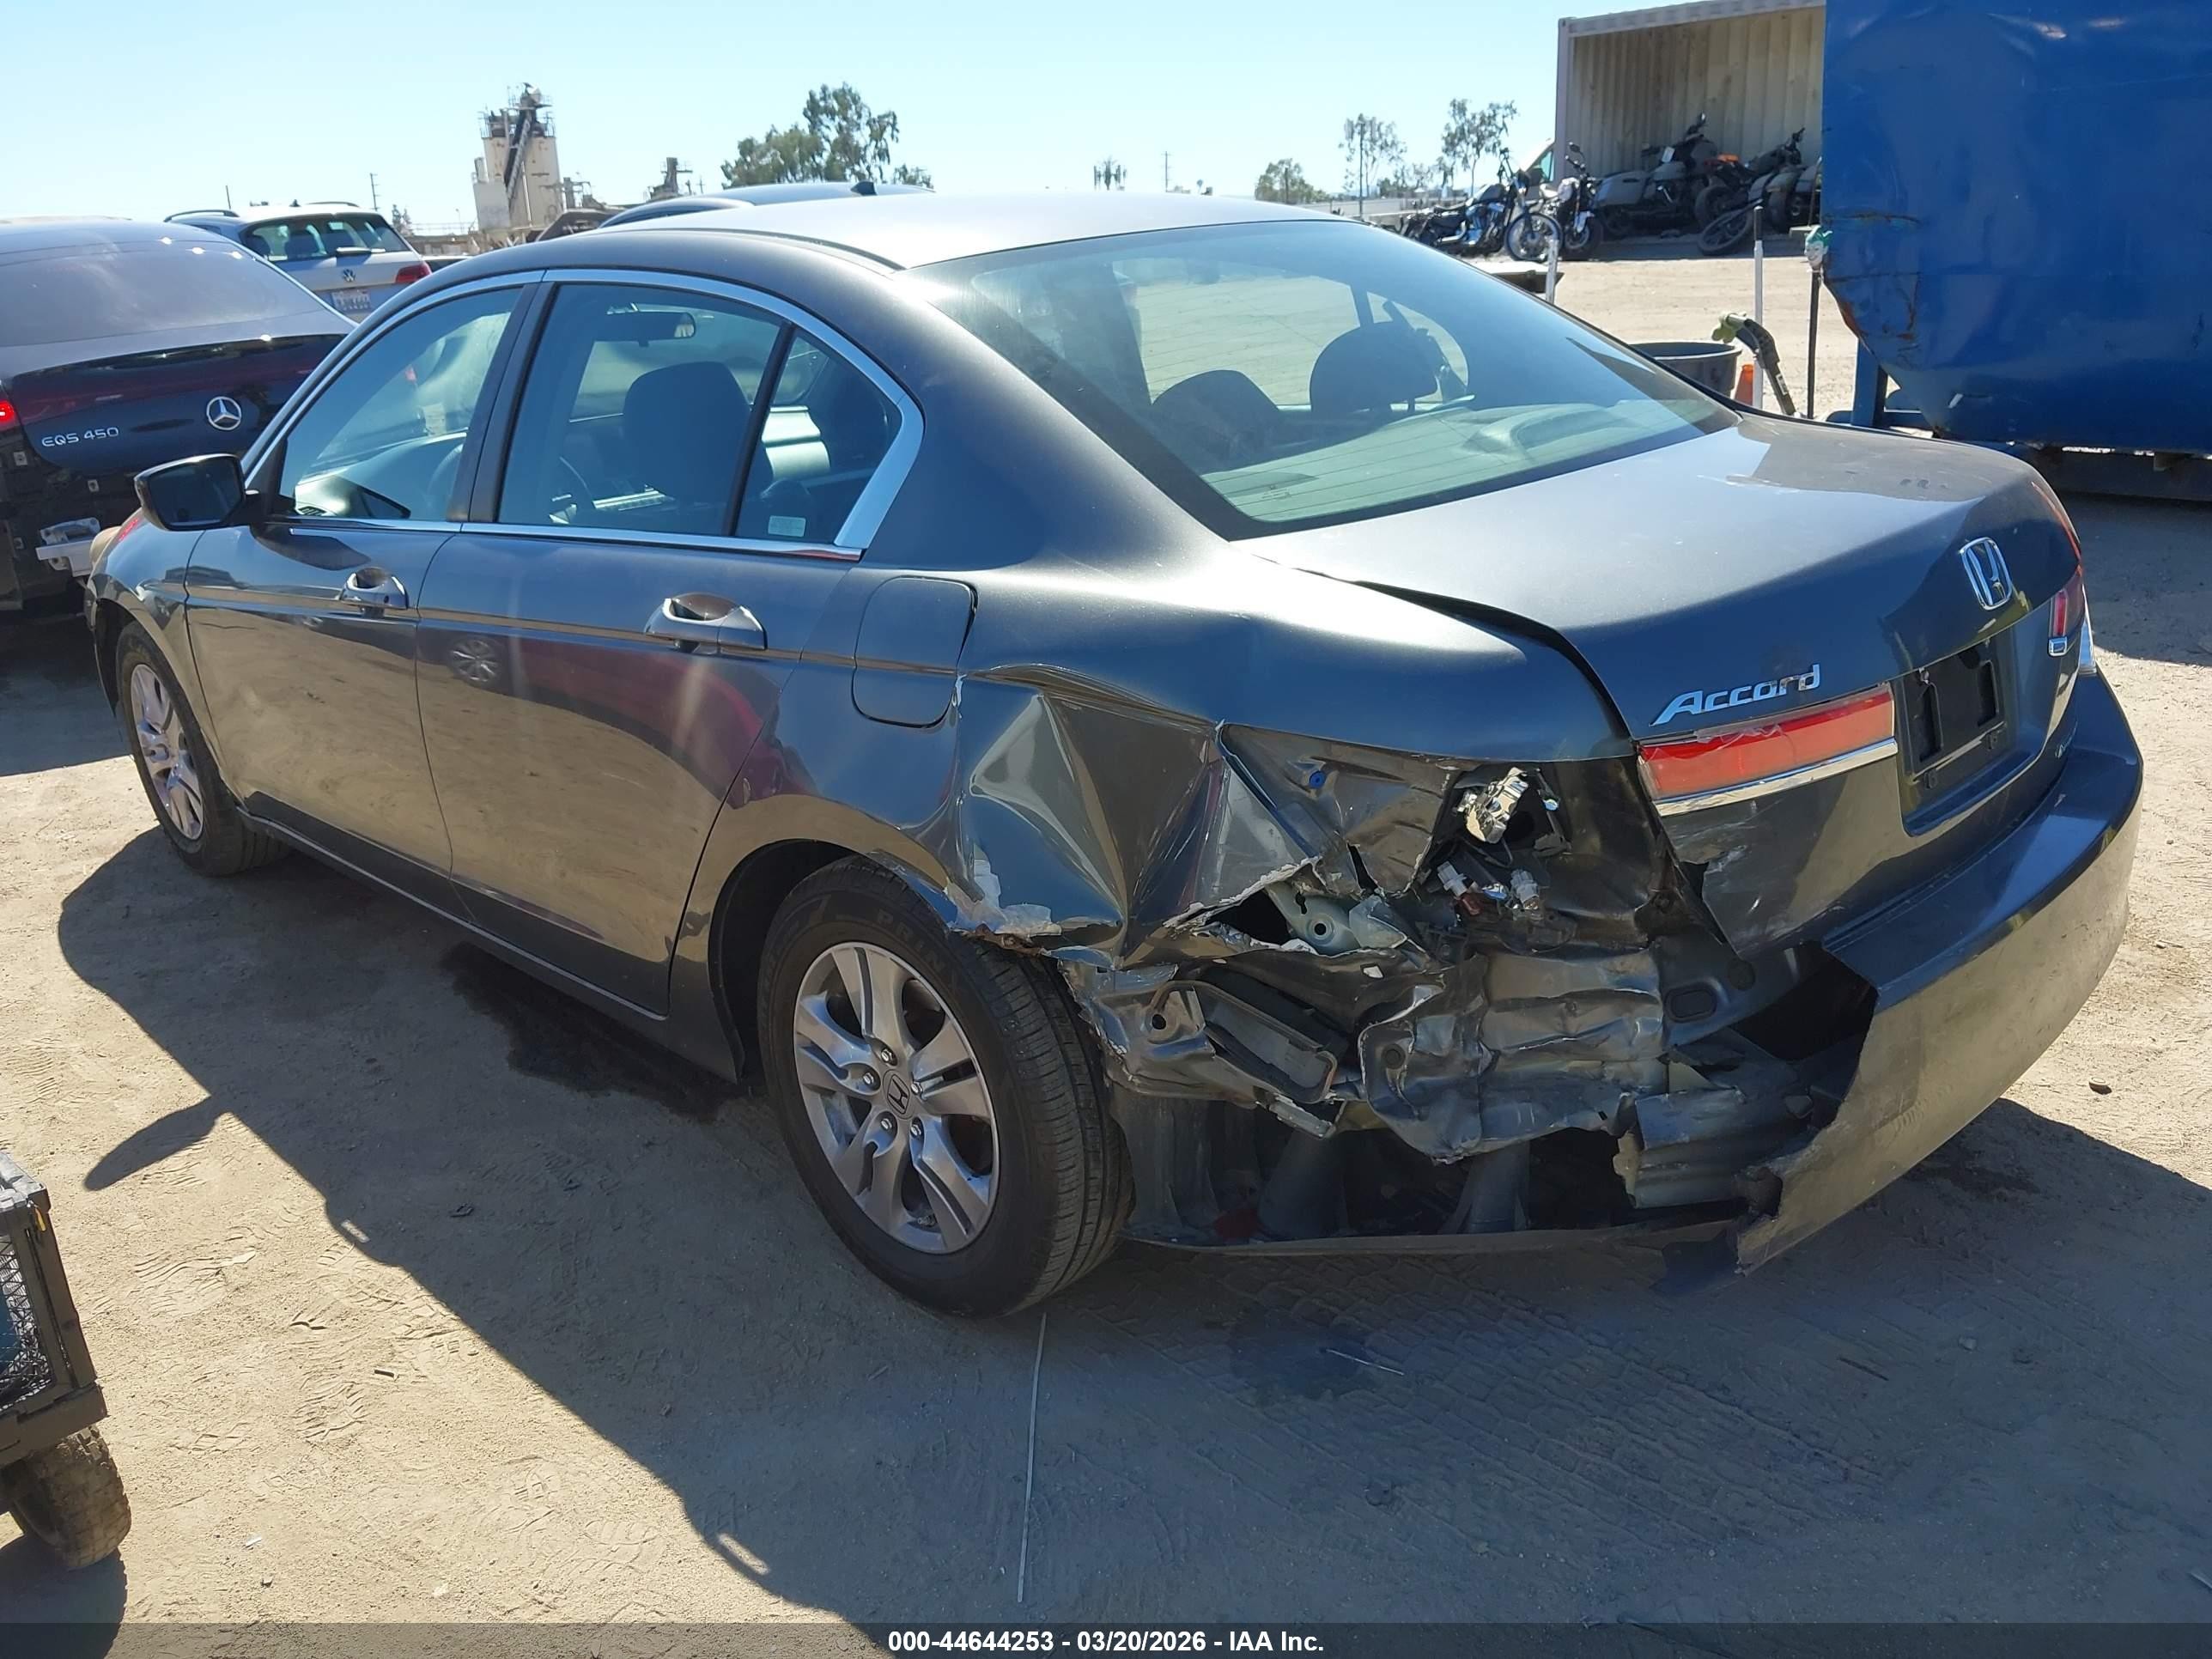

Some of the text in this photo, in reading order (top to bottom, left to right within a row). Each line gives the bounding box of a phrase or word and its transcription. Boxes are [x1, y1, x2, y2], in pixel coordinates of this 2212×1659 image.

[41, 427, 119, 447] EQS 450
[1649, 664, 1820, 727] Accord
